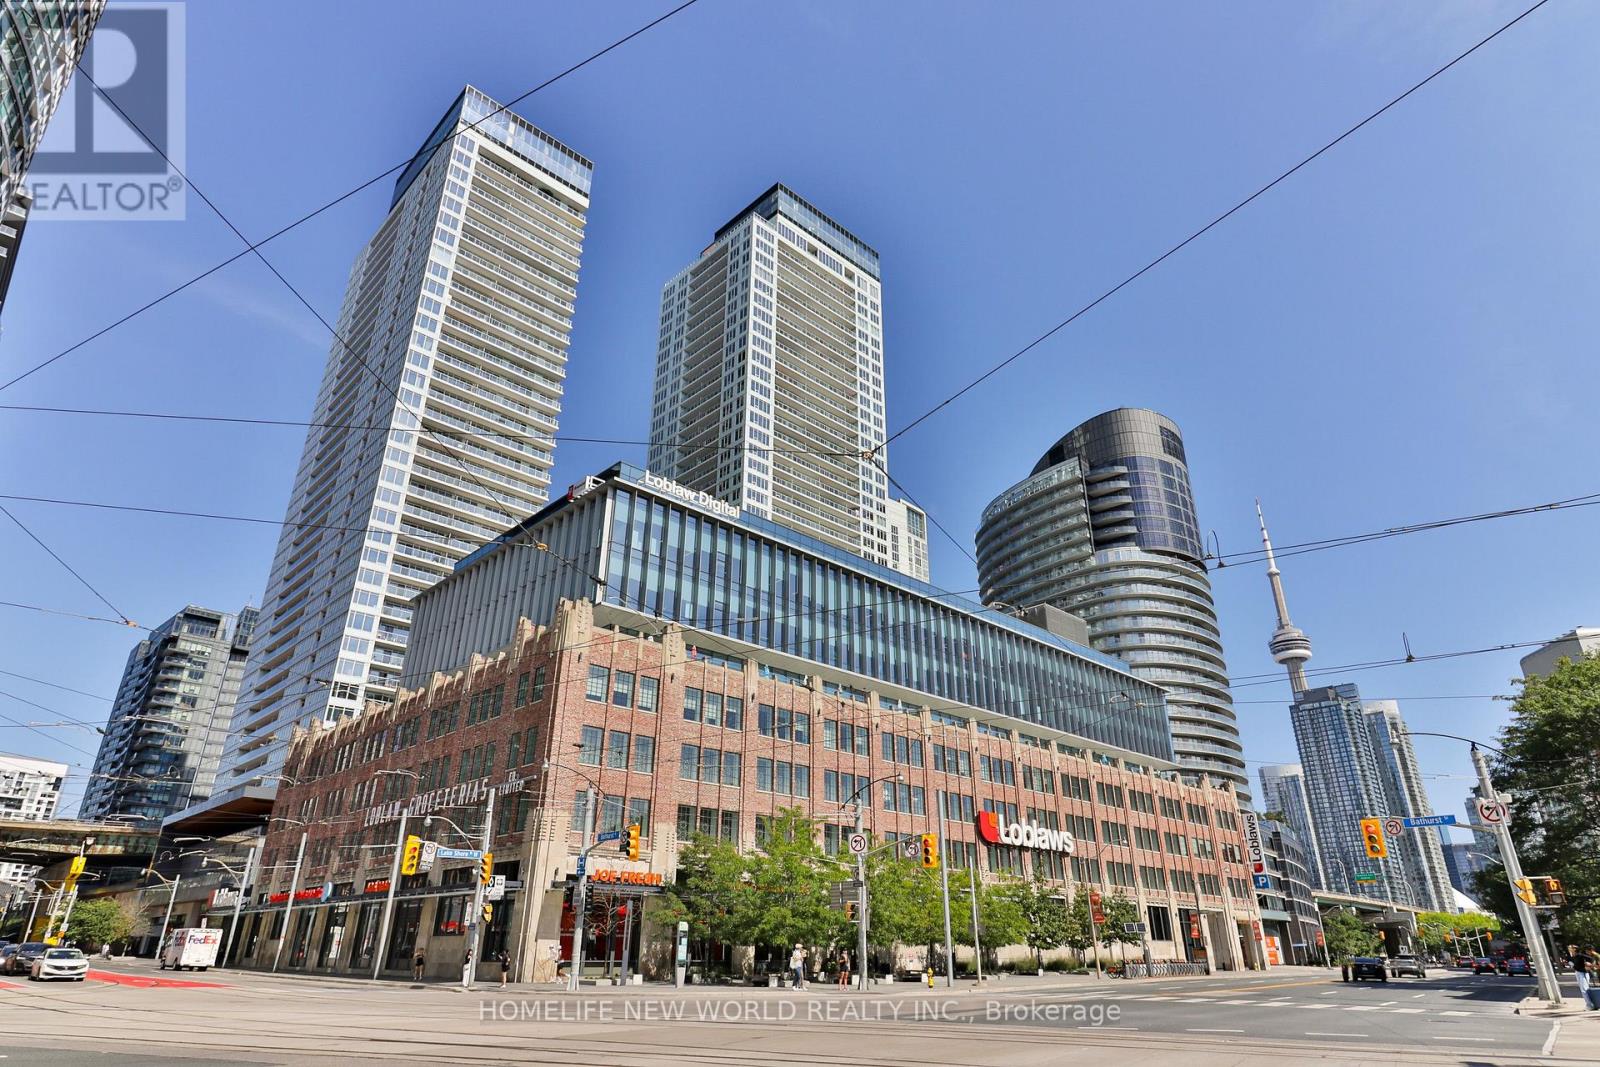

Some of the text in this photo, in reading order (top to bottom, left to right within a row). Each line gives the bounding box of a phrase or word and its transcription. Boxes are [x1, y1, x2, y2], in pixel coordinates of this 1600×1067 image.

[645, 470, 740, 518] Loblaw Digital
[1410, 817, 1443, 826] Bathurst
[998, 813, 1075, 854] Loblaws
[1246, 815, 1262, 862] Loblaws
[592, 869, 617, 884] JOE
[1259, 877, 1267, 887] P
[188, 934, 218, 945] FedEx
